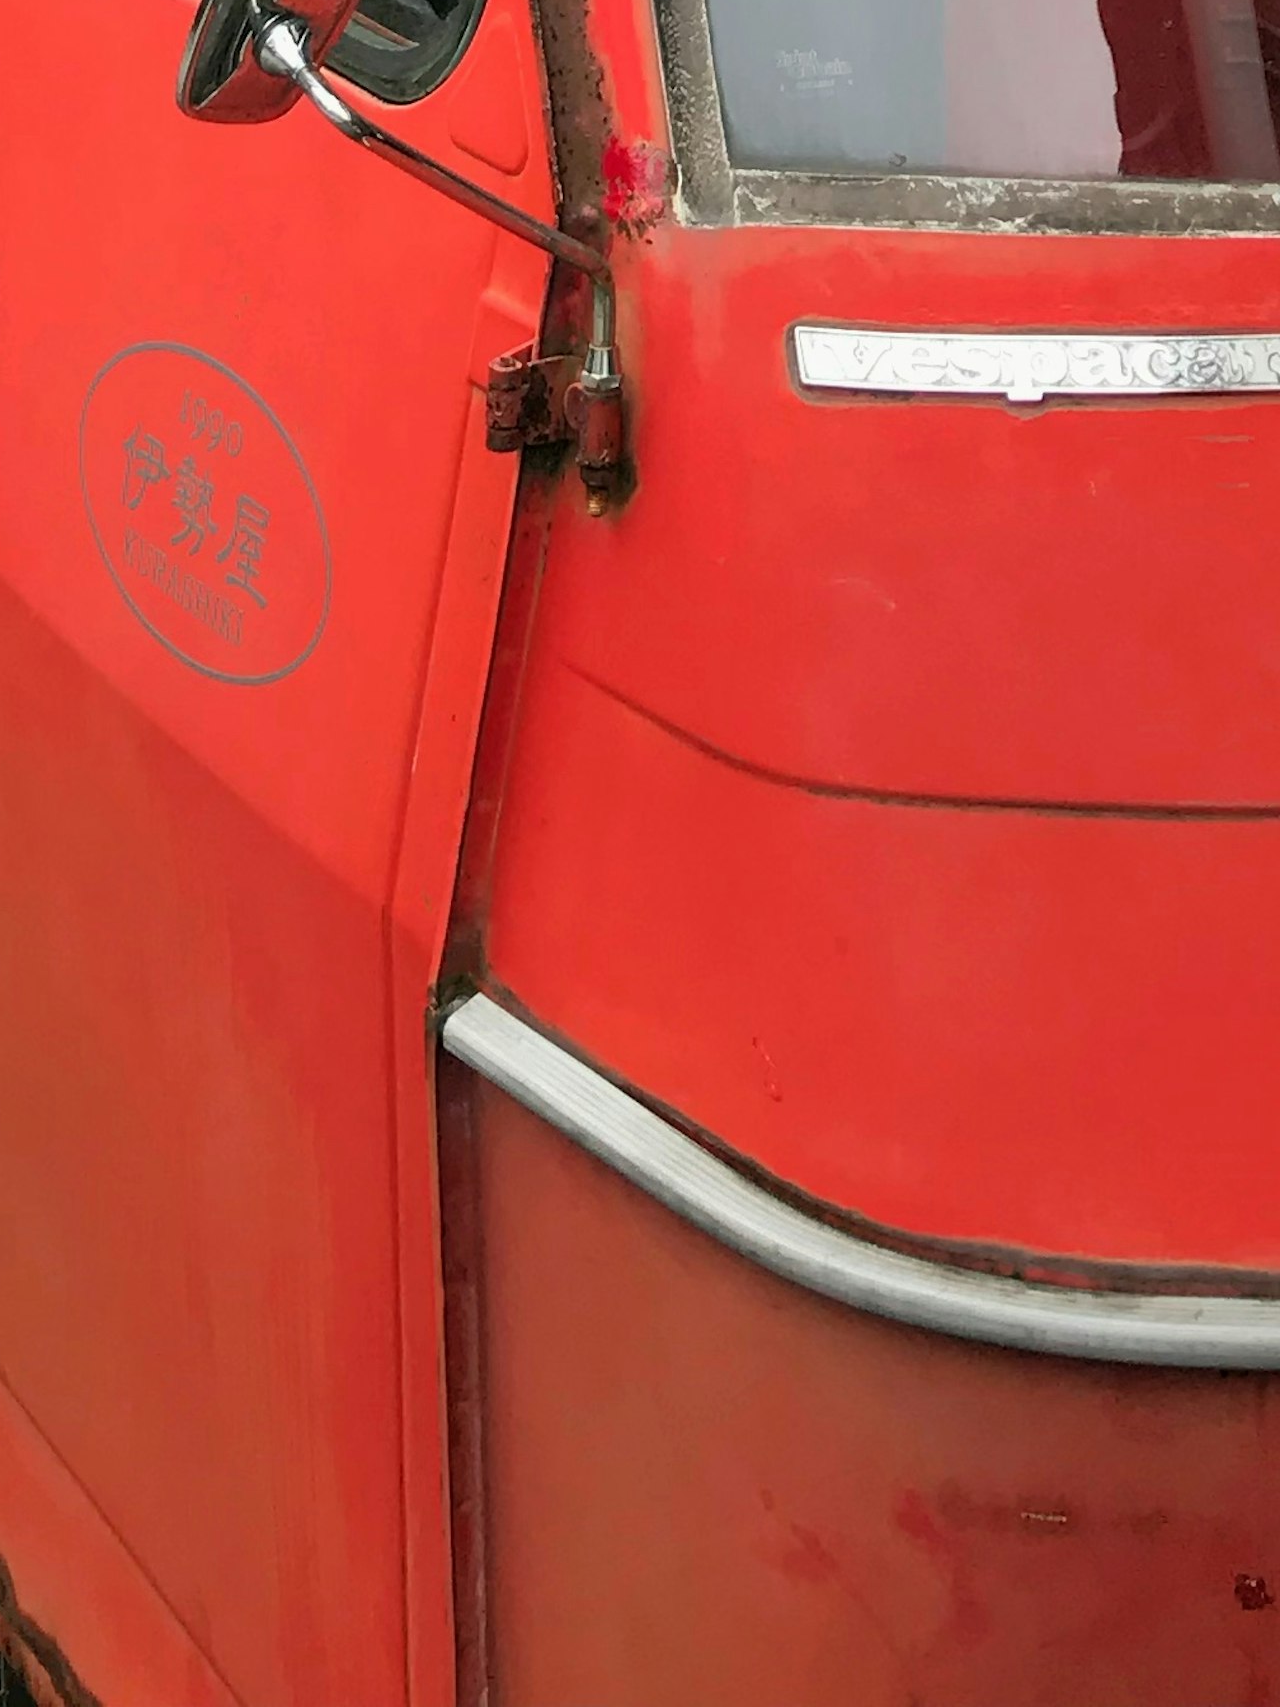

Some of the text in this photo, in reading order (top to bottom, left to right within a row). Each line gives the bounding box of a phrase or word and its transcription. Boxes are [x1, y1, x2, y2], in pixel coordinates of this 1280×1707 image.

[180, 388, 243, 458] 1990
[122, 423, 271, 610] 伊勢屋
